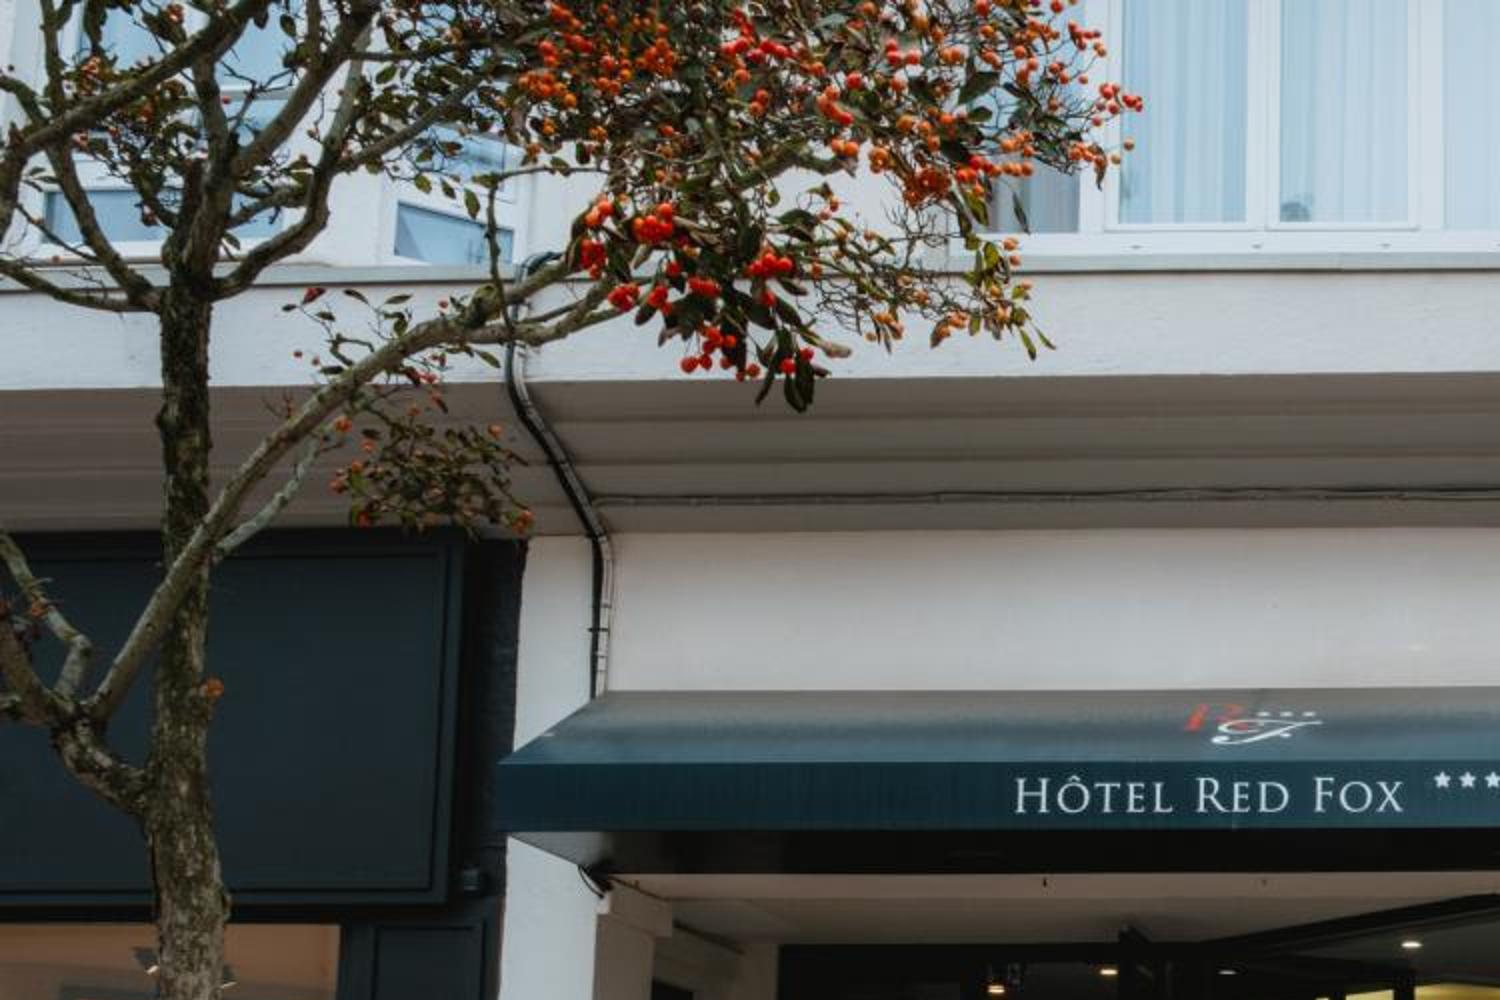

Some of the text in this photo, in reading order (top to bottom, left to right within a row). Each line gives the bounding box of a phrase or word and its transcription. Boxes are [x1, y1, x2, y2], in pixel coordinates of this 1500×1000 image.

[1014, 775, 1405, 814] HÔTEL RED FOX
